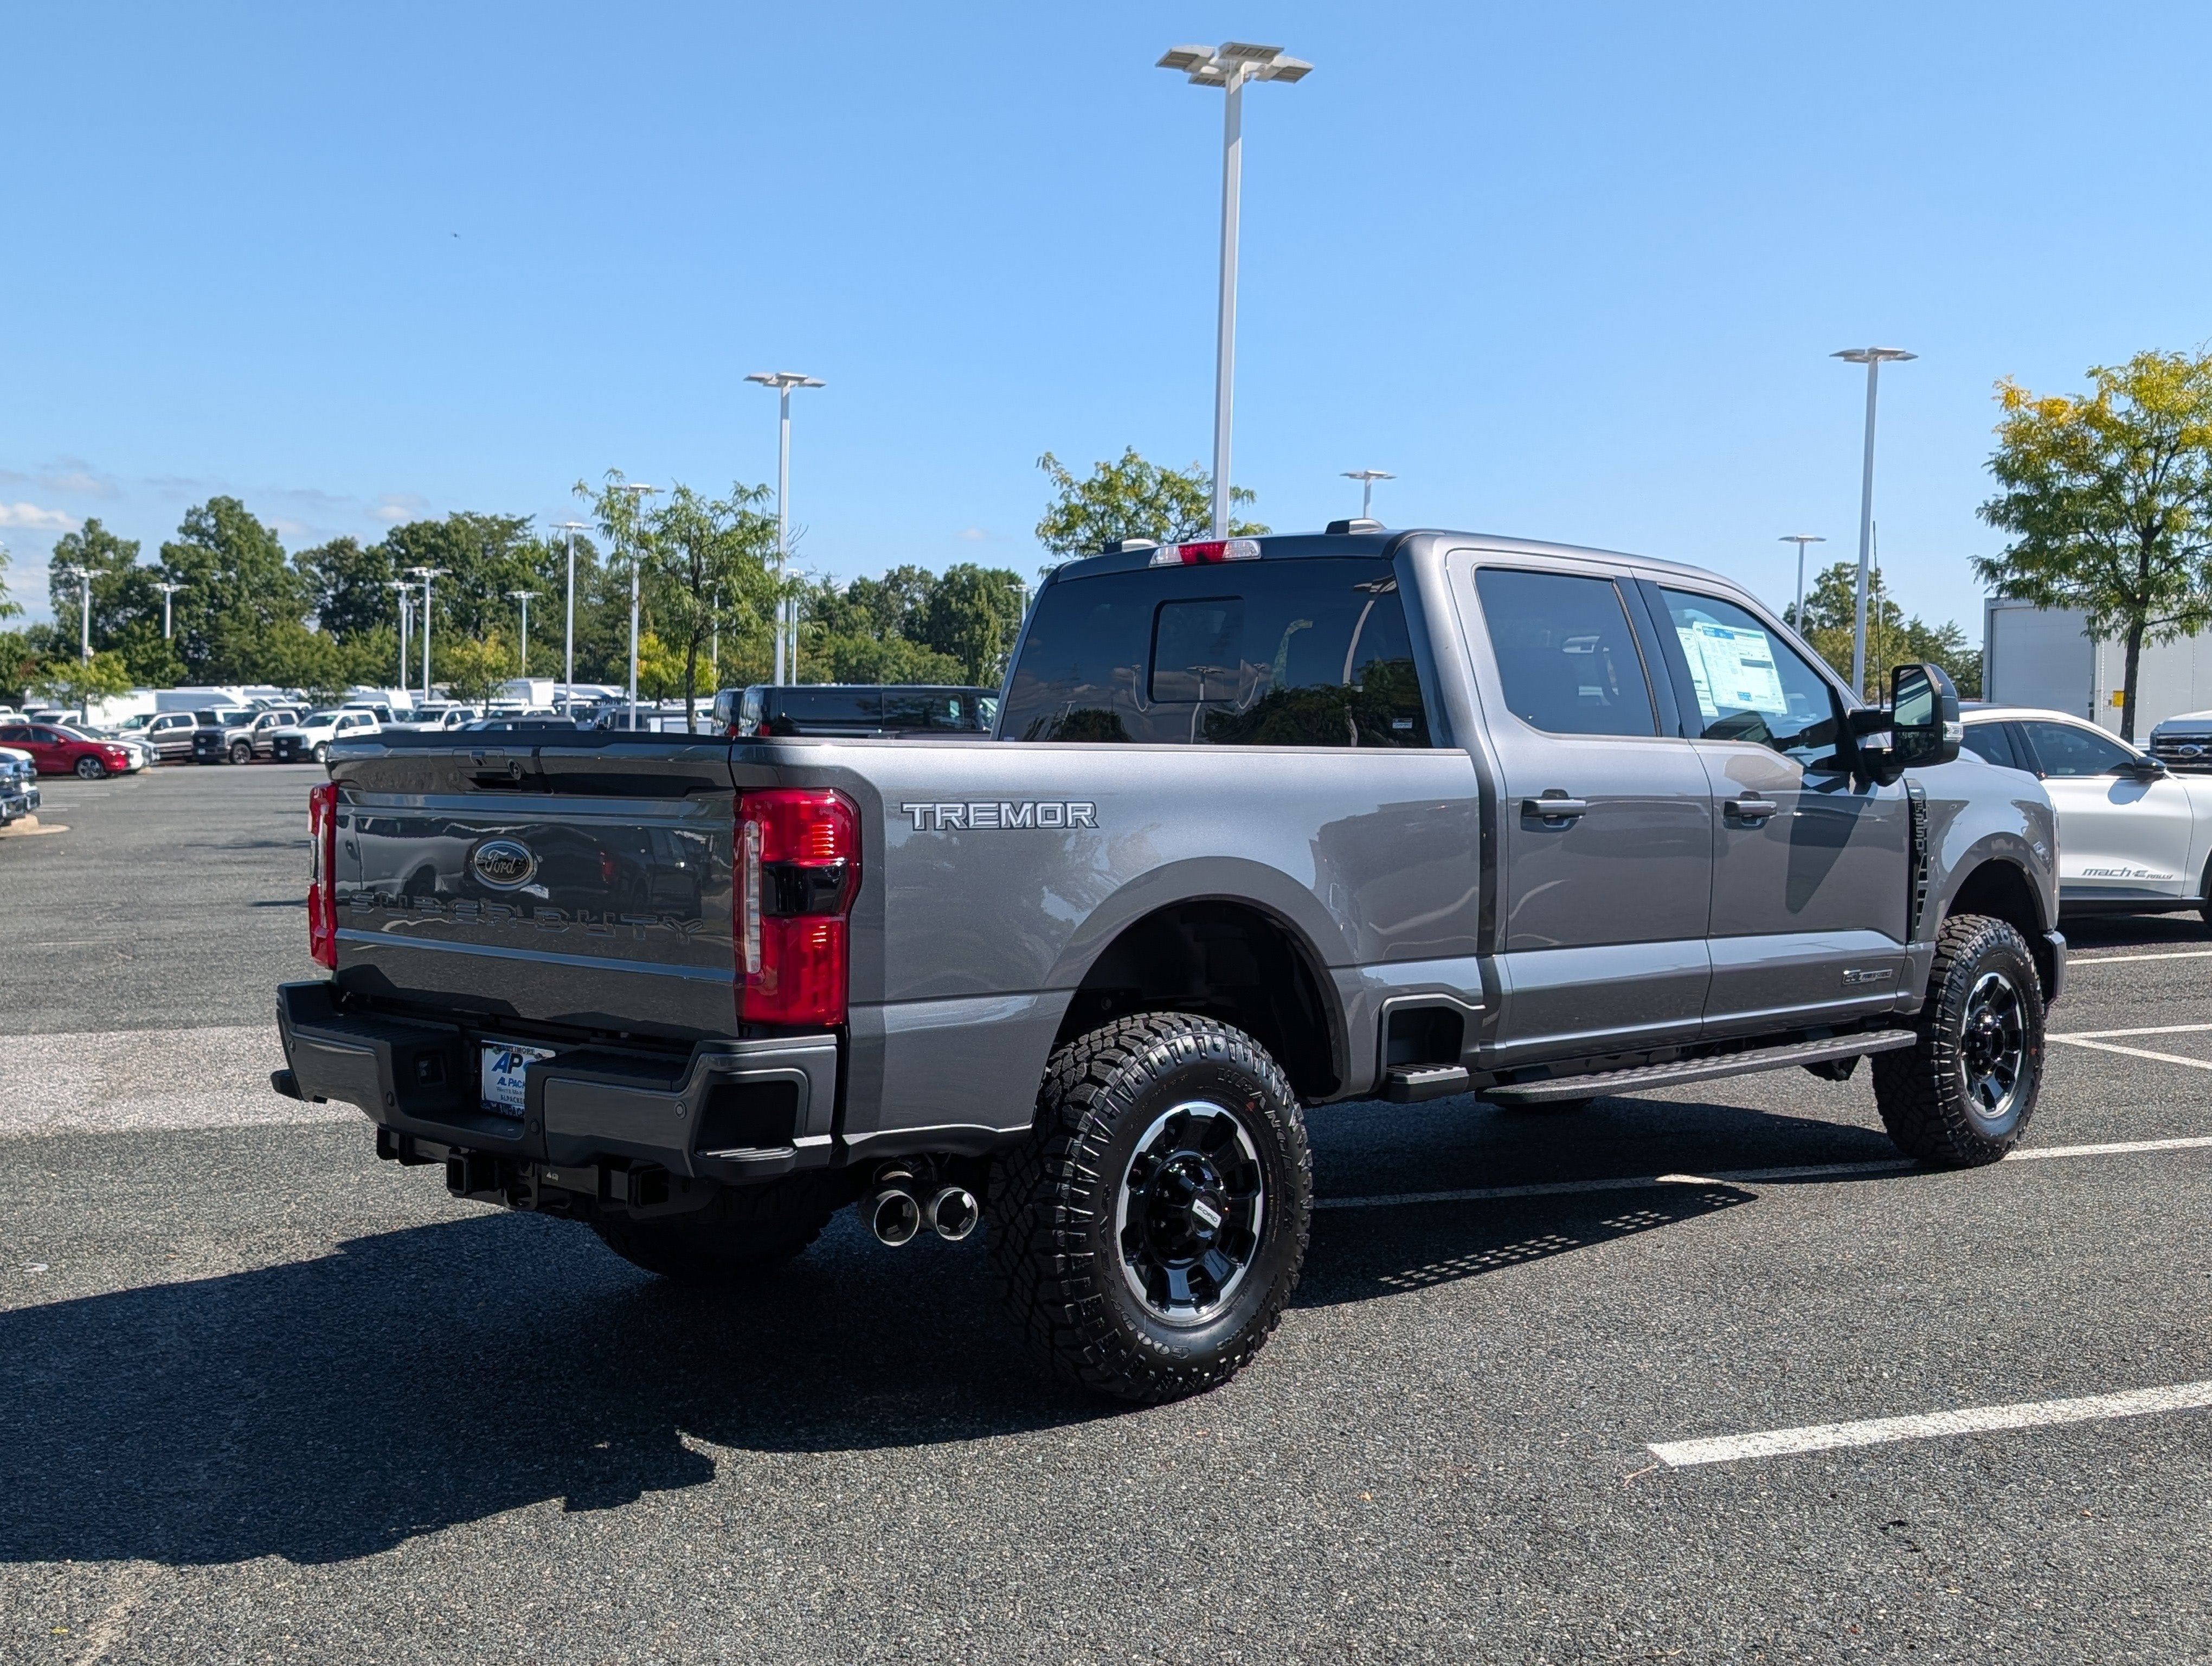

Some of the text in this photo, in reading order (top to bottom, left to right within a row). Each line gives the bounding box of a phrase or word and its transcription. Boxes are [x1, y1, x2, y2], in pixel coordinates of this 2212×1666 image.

[901, 802, 1100, 831] TREMOR
[485, 849, 517, 874] Ford
[350, 890, 704, 946] SUPER DUTY
[491, 1052, 524, 1074] AP
[497, 1077, 507, 1086] AL
[1196, 1205, 1218, 1223] FORD
